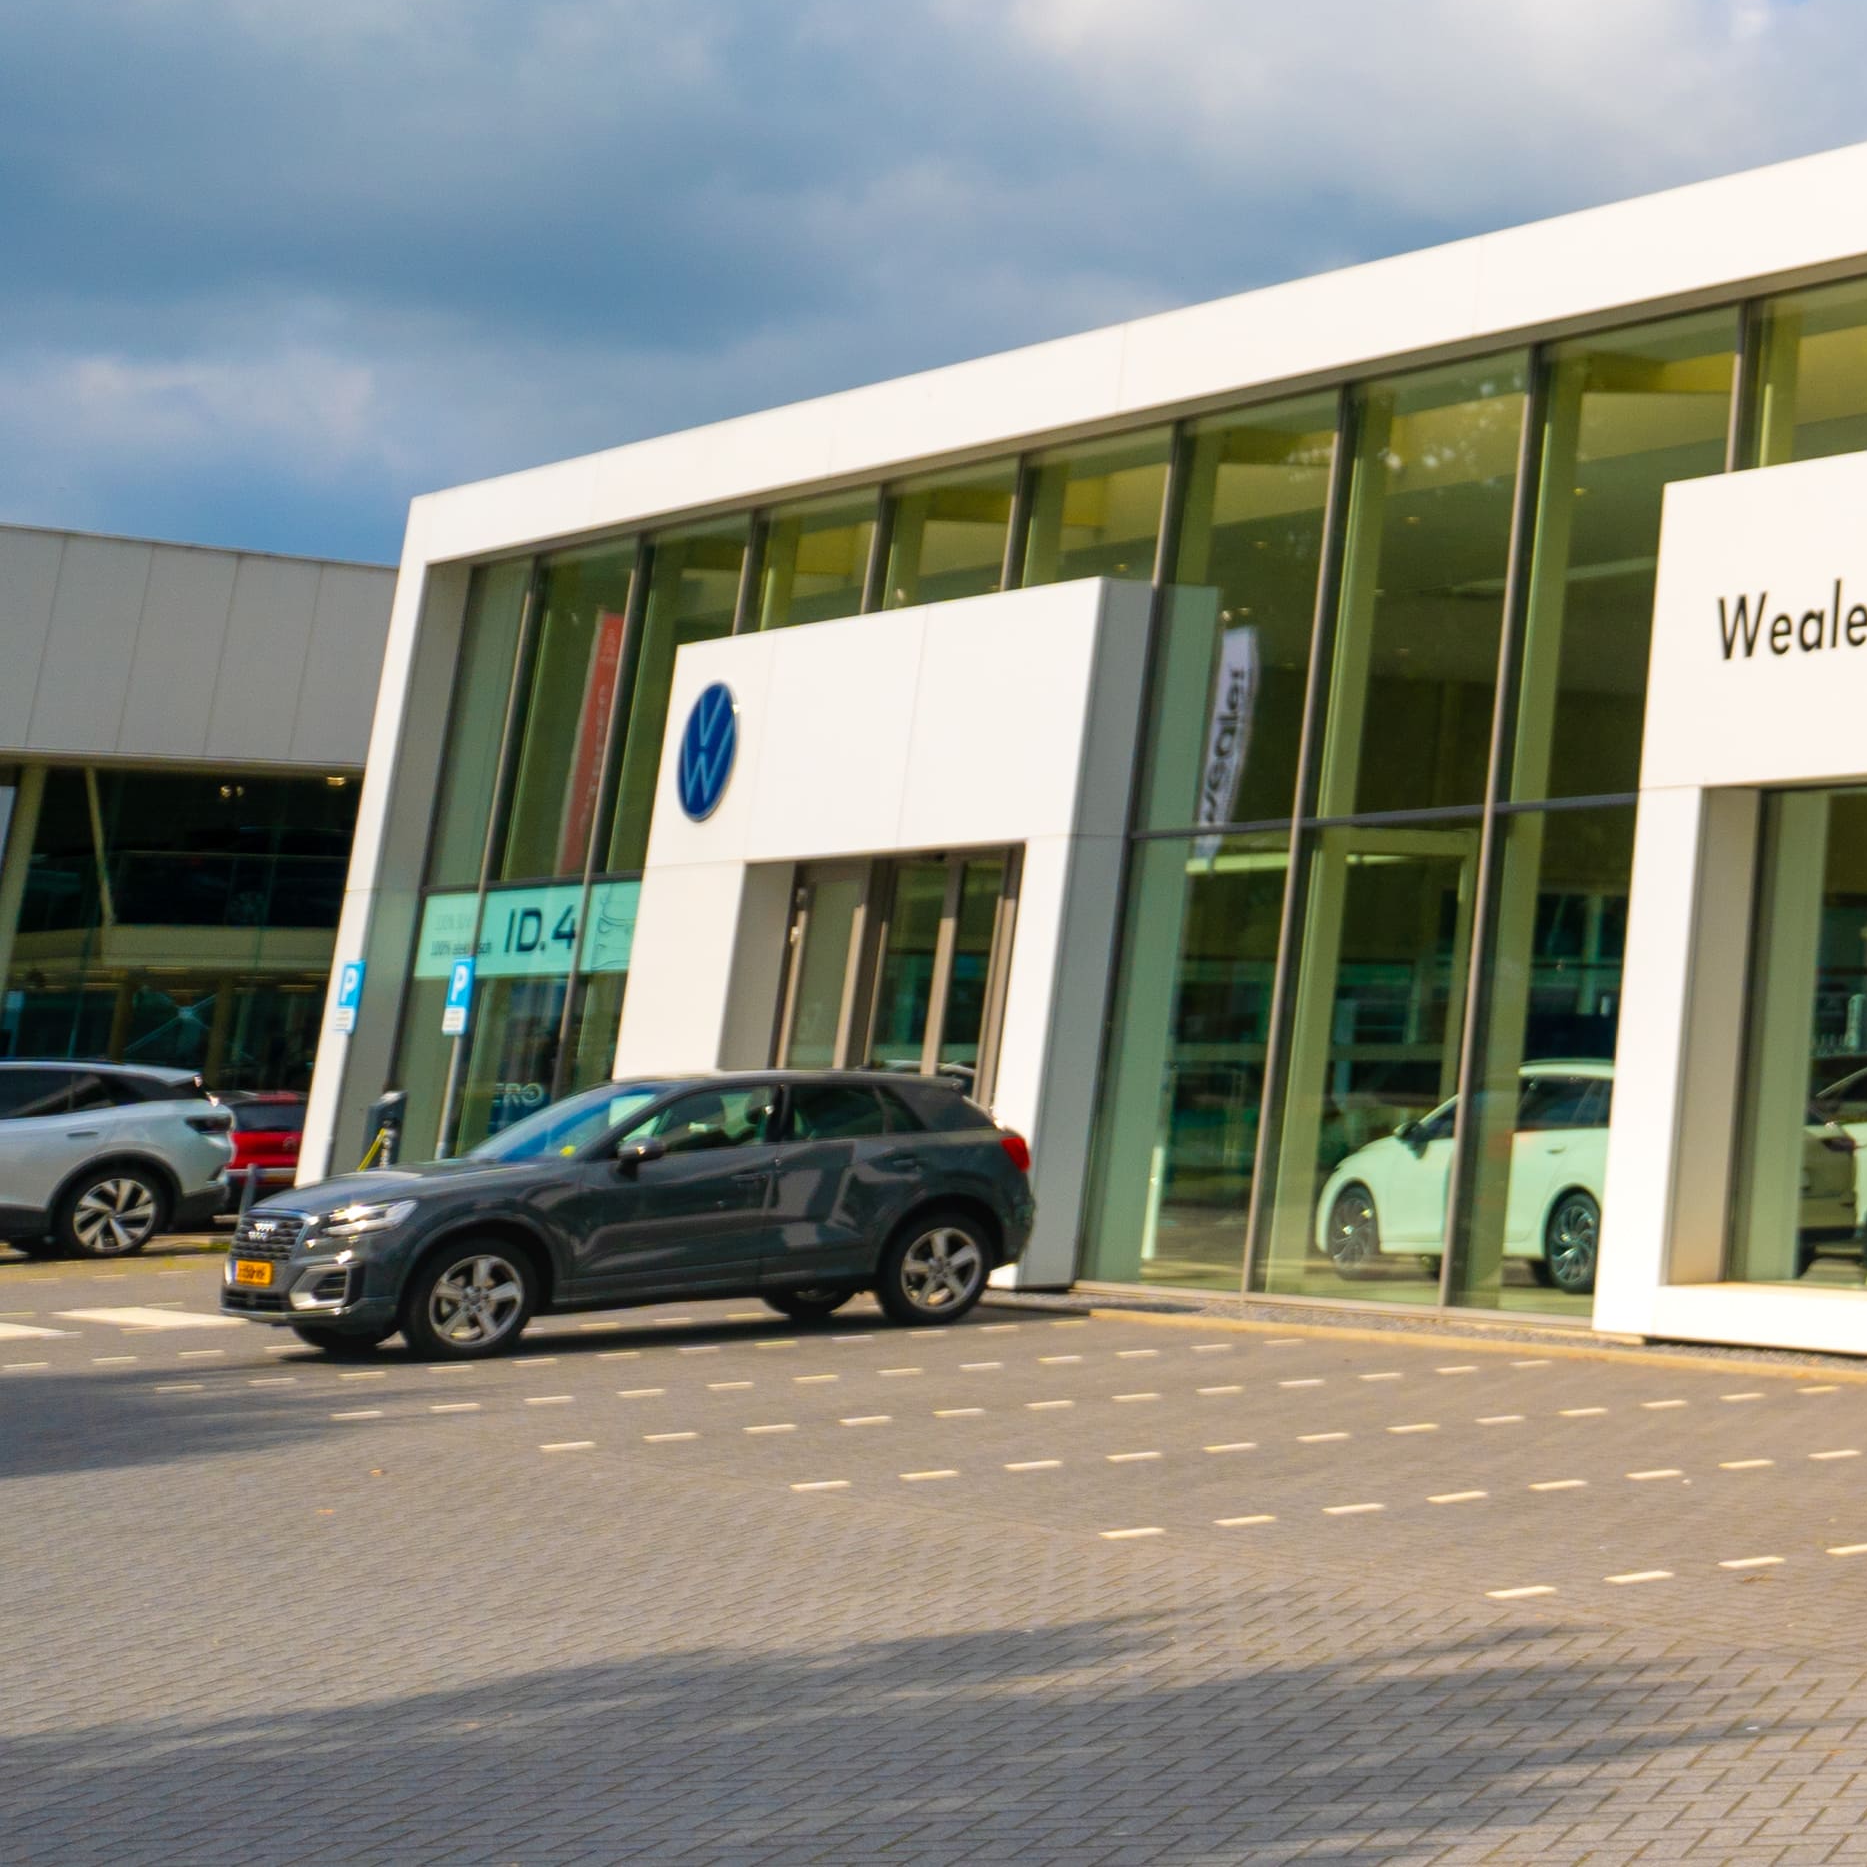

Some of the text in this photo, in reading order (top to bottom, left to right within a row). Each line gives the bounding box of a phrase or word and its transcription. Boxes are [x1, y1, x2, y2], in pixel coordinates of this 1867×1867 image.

[504, 904, 577, 953] ID.4
[340, 967, 358, 1004] P
[451, 964, 469, 1002] P
